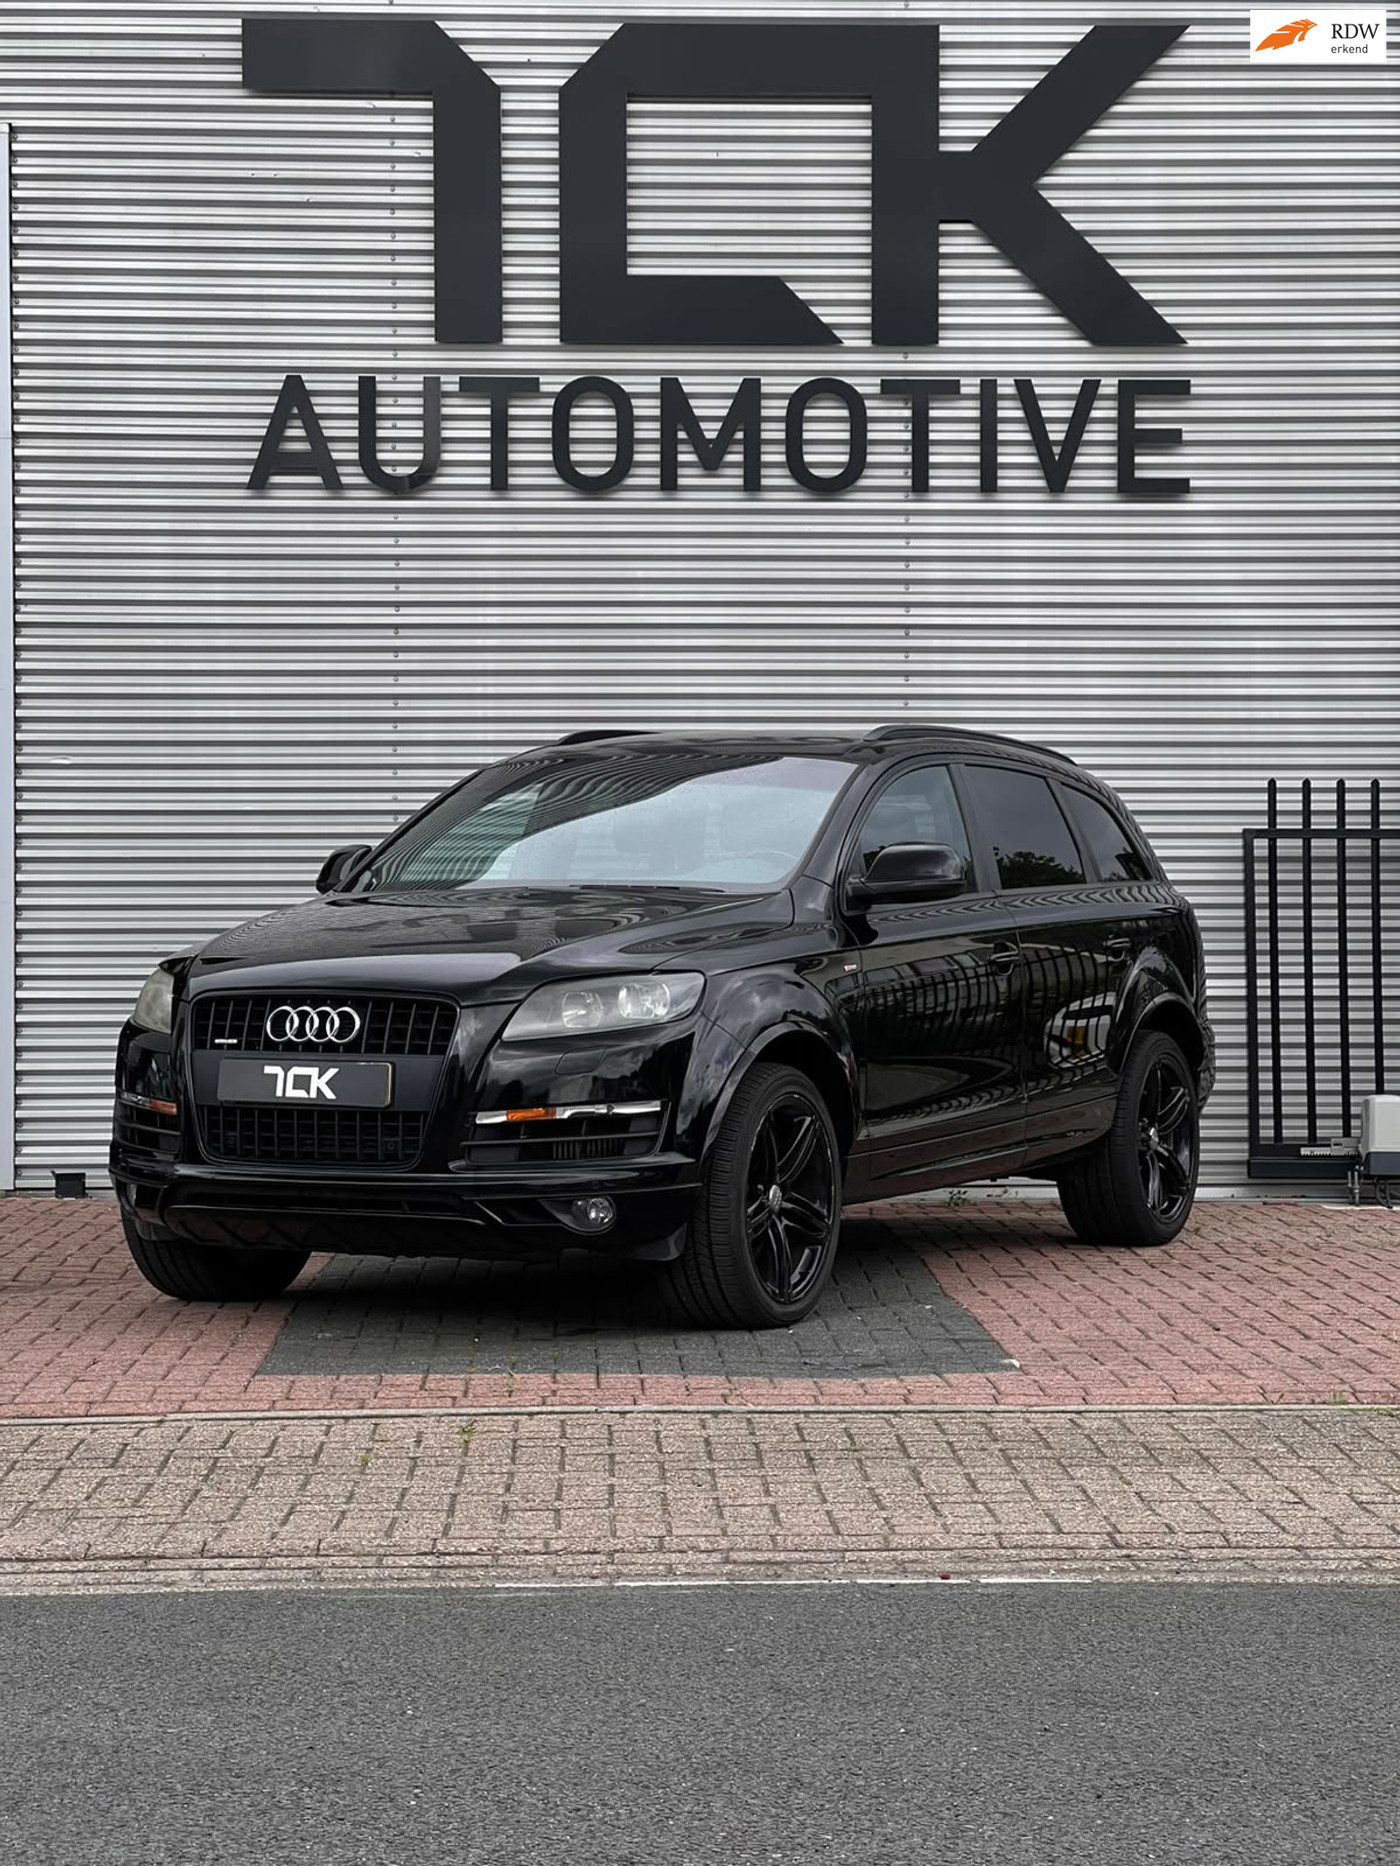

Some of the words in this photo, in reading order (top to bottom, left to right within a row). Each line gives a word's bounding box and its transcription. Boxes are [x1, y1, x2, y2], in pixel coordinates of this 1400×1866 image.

[241, 18, 1190, 346] TCK
[247, 374, 1192, 496] AUTOMOTIVE
[263, 1065, 340, 1100] TCK
